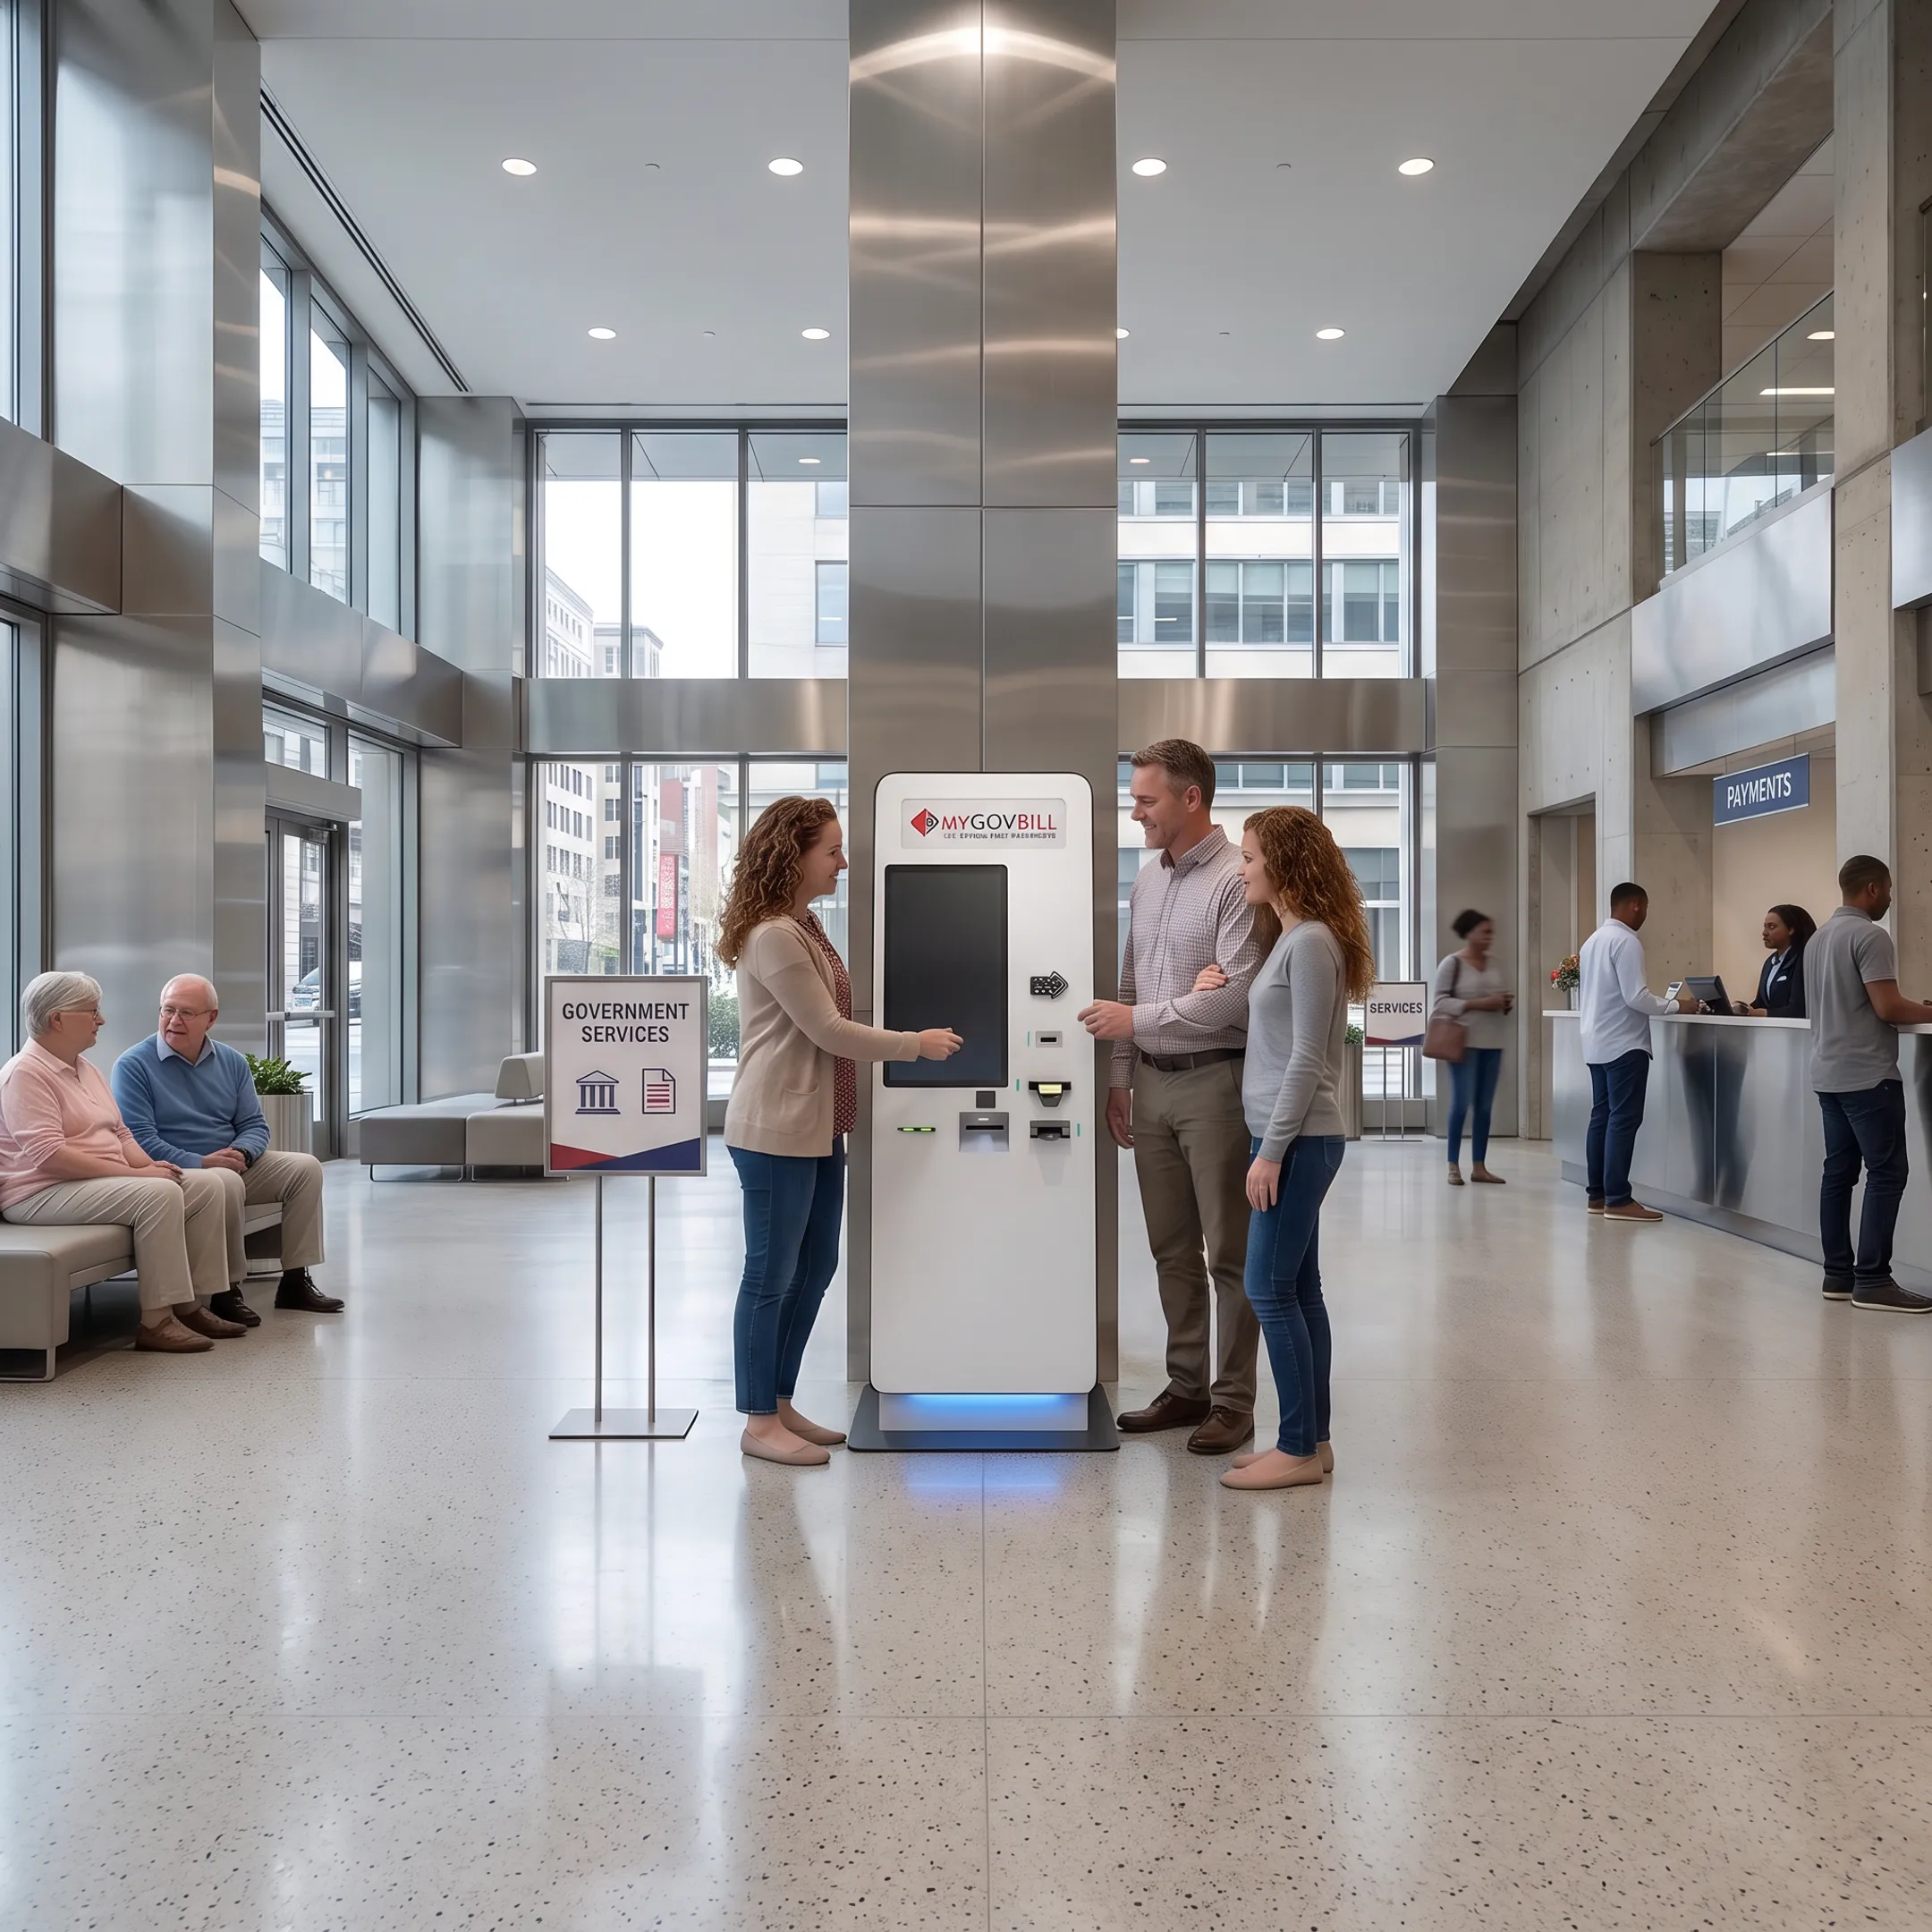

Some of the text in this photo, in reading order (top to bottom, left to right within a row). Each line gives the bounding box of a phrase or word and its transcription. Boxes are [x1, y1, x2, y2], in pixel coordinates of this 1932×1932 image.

[1727, 772, 1792, 809] PAYMENTS
[942, 814, 1057, 830] MYGOVBILL
[562, 1003, 690, 1020] GOVERNMENT
[1369, 1003, 1423, 1013] SERVICES
[581, 1026, 669, 1042] SERVICES
